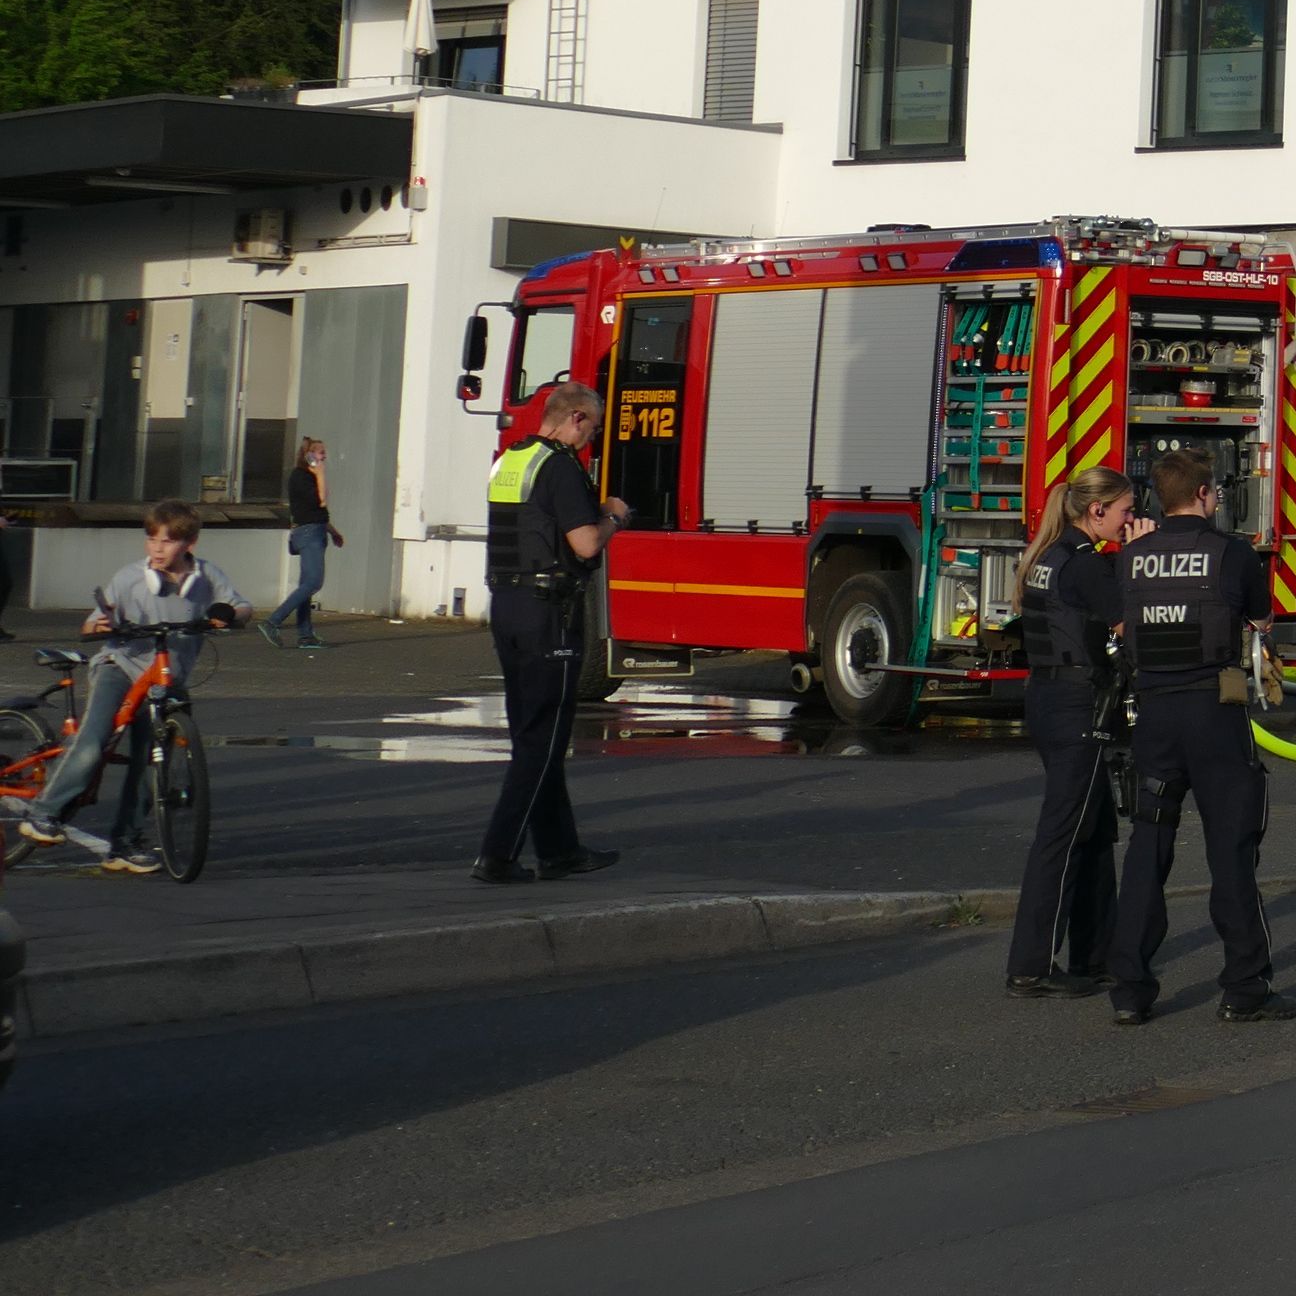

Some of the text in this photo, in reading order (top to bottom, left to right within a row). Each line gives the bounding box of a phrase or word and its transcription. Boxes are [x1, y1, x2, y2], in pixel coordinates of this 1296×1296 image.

[1203, 270, 1278, 285] SGB-OST-HLF-10
[621, 390, 676, 403] FEUERWEHR
[638, 408, 674, 437] 112
[1132, 553, 1209, 579] POLIZEI
[1143, 605, 1187, 624] NRW
